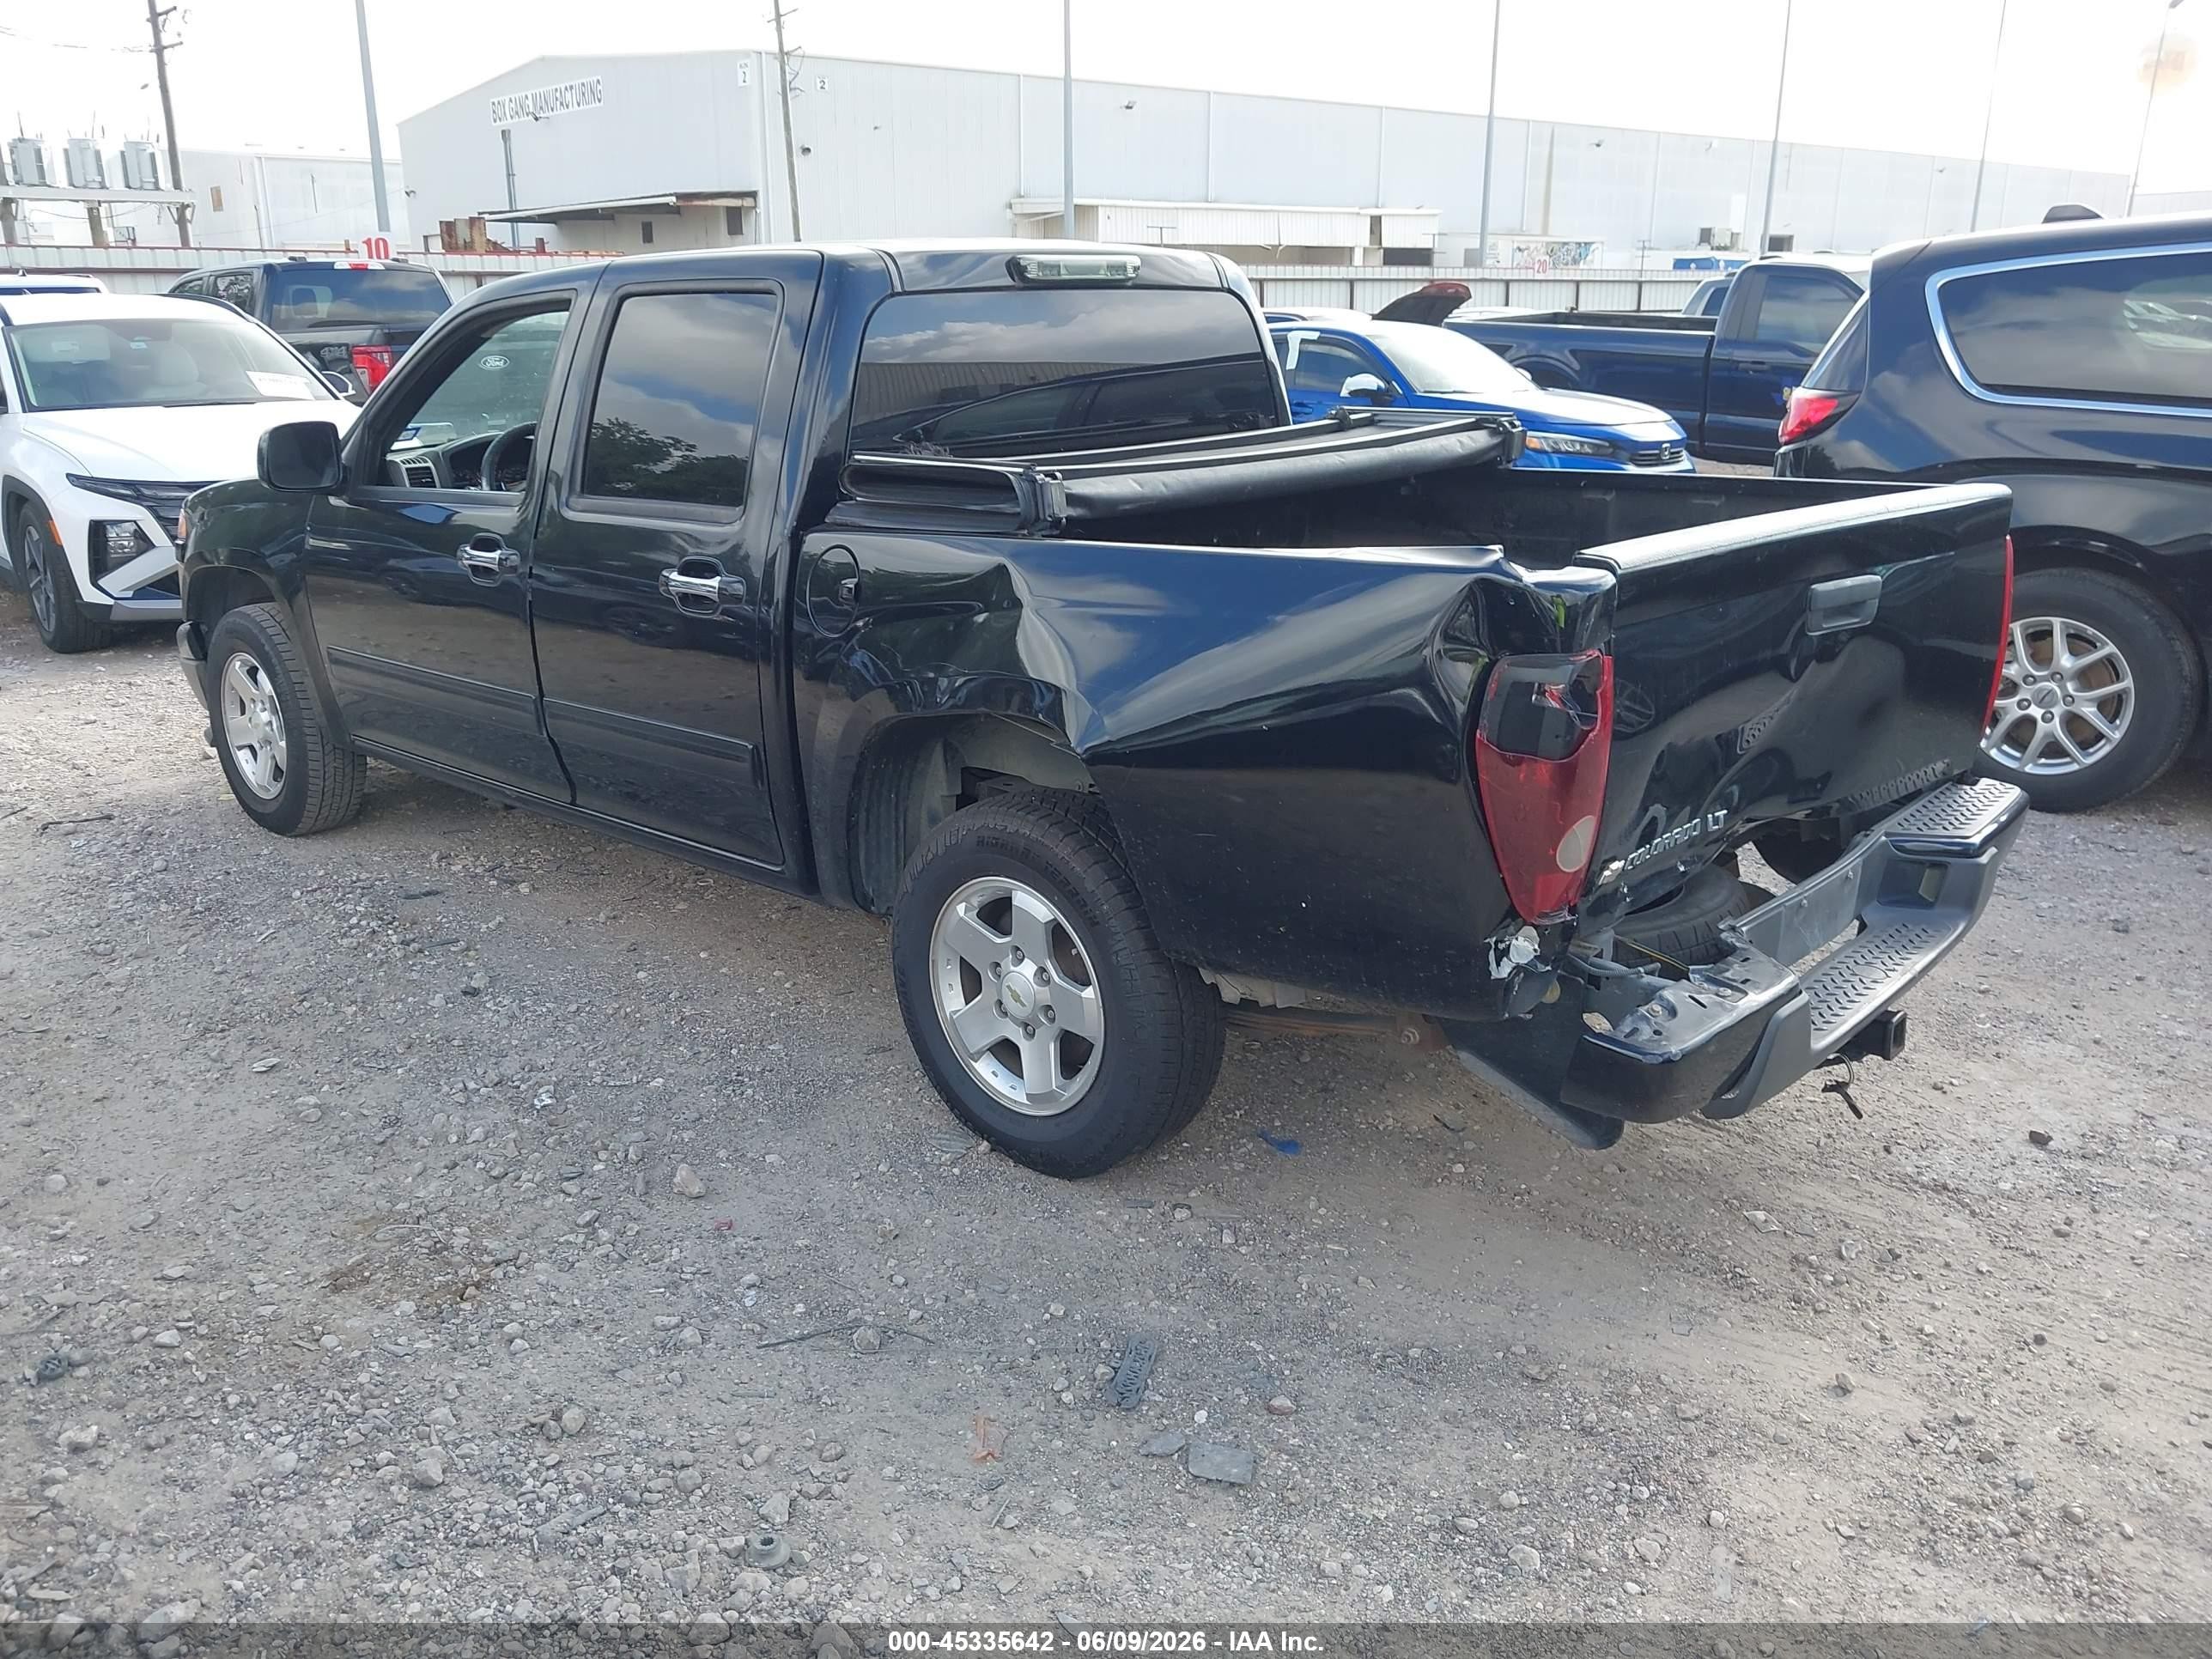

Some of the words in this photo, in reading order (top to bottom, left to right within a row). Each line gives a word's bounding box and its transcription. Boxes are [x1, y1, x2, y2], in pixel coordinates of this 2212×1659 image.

[818, 79, 826, 90] 2
[491, 100, 507, 124] BOX
[508, 94, 532, 121] GANG
[532, 78, 603, 114] MANUFACTURING
[362, 237, 390, 260] 10
[1536, 258, 1547, 274] 20
[1625, 817, 1701, 871] COLORADO
[1707, 809, 1729, 832] LT
